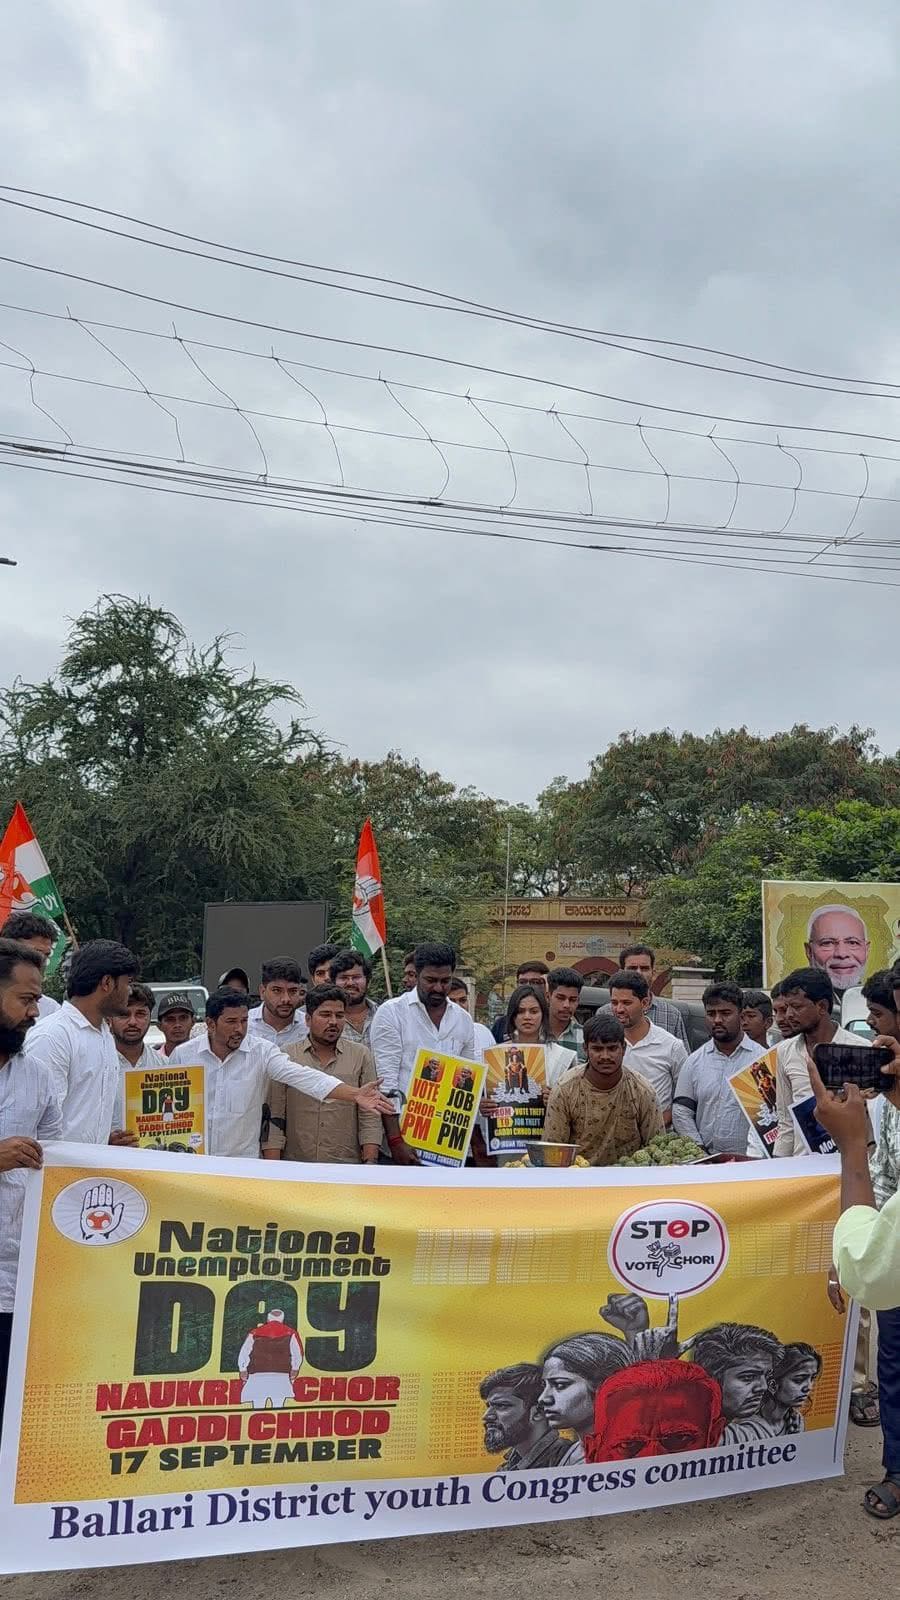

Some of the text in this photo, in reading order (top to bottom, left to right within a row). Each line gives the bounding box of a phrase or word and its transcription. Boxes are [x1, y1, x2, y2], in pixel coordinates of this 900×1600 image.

[145, 1071, 187, 1082] National
[142, 1087, 189, 1114] DAY
[412, 1079, 440, 1102] VOTE
[447, 1088, 475, 1112] JOB
[407, 1099, 435, 1118] CHOR
[443, 1110, 471, 1128] CHOR
[149, 1128, 191, 1137] SEPTEMBER
[401, 1113, 432, 1141] PM
[436, 1122, 467, 1151] PM
[158, 1220, 376, 1255] National
[631, 1220, 710, 1239] STOP
[133, 1252, 390, 1281] Unemployment
[625, 1261, 660, 1271] VOTE
[674, 1255, 715, 1265] CHORI
[133, 1279, 380, 1376] DAY
[95, 1379, 242, 1412] NAUKRI
[293, 1376, 401, 1402] CHOR
[106, 1409, 391, 1449] GADDI CHHOD
[109, 1450, 149, 1475] 17
[159, 1438, 382, 1471] SEPTEMBER
[48, 1443, 797, 1539] Ballari District youth Congress committee
